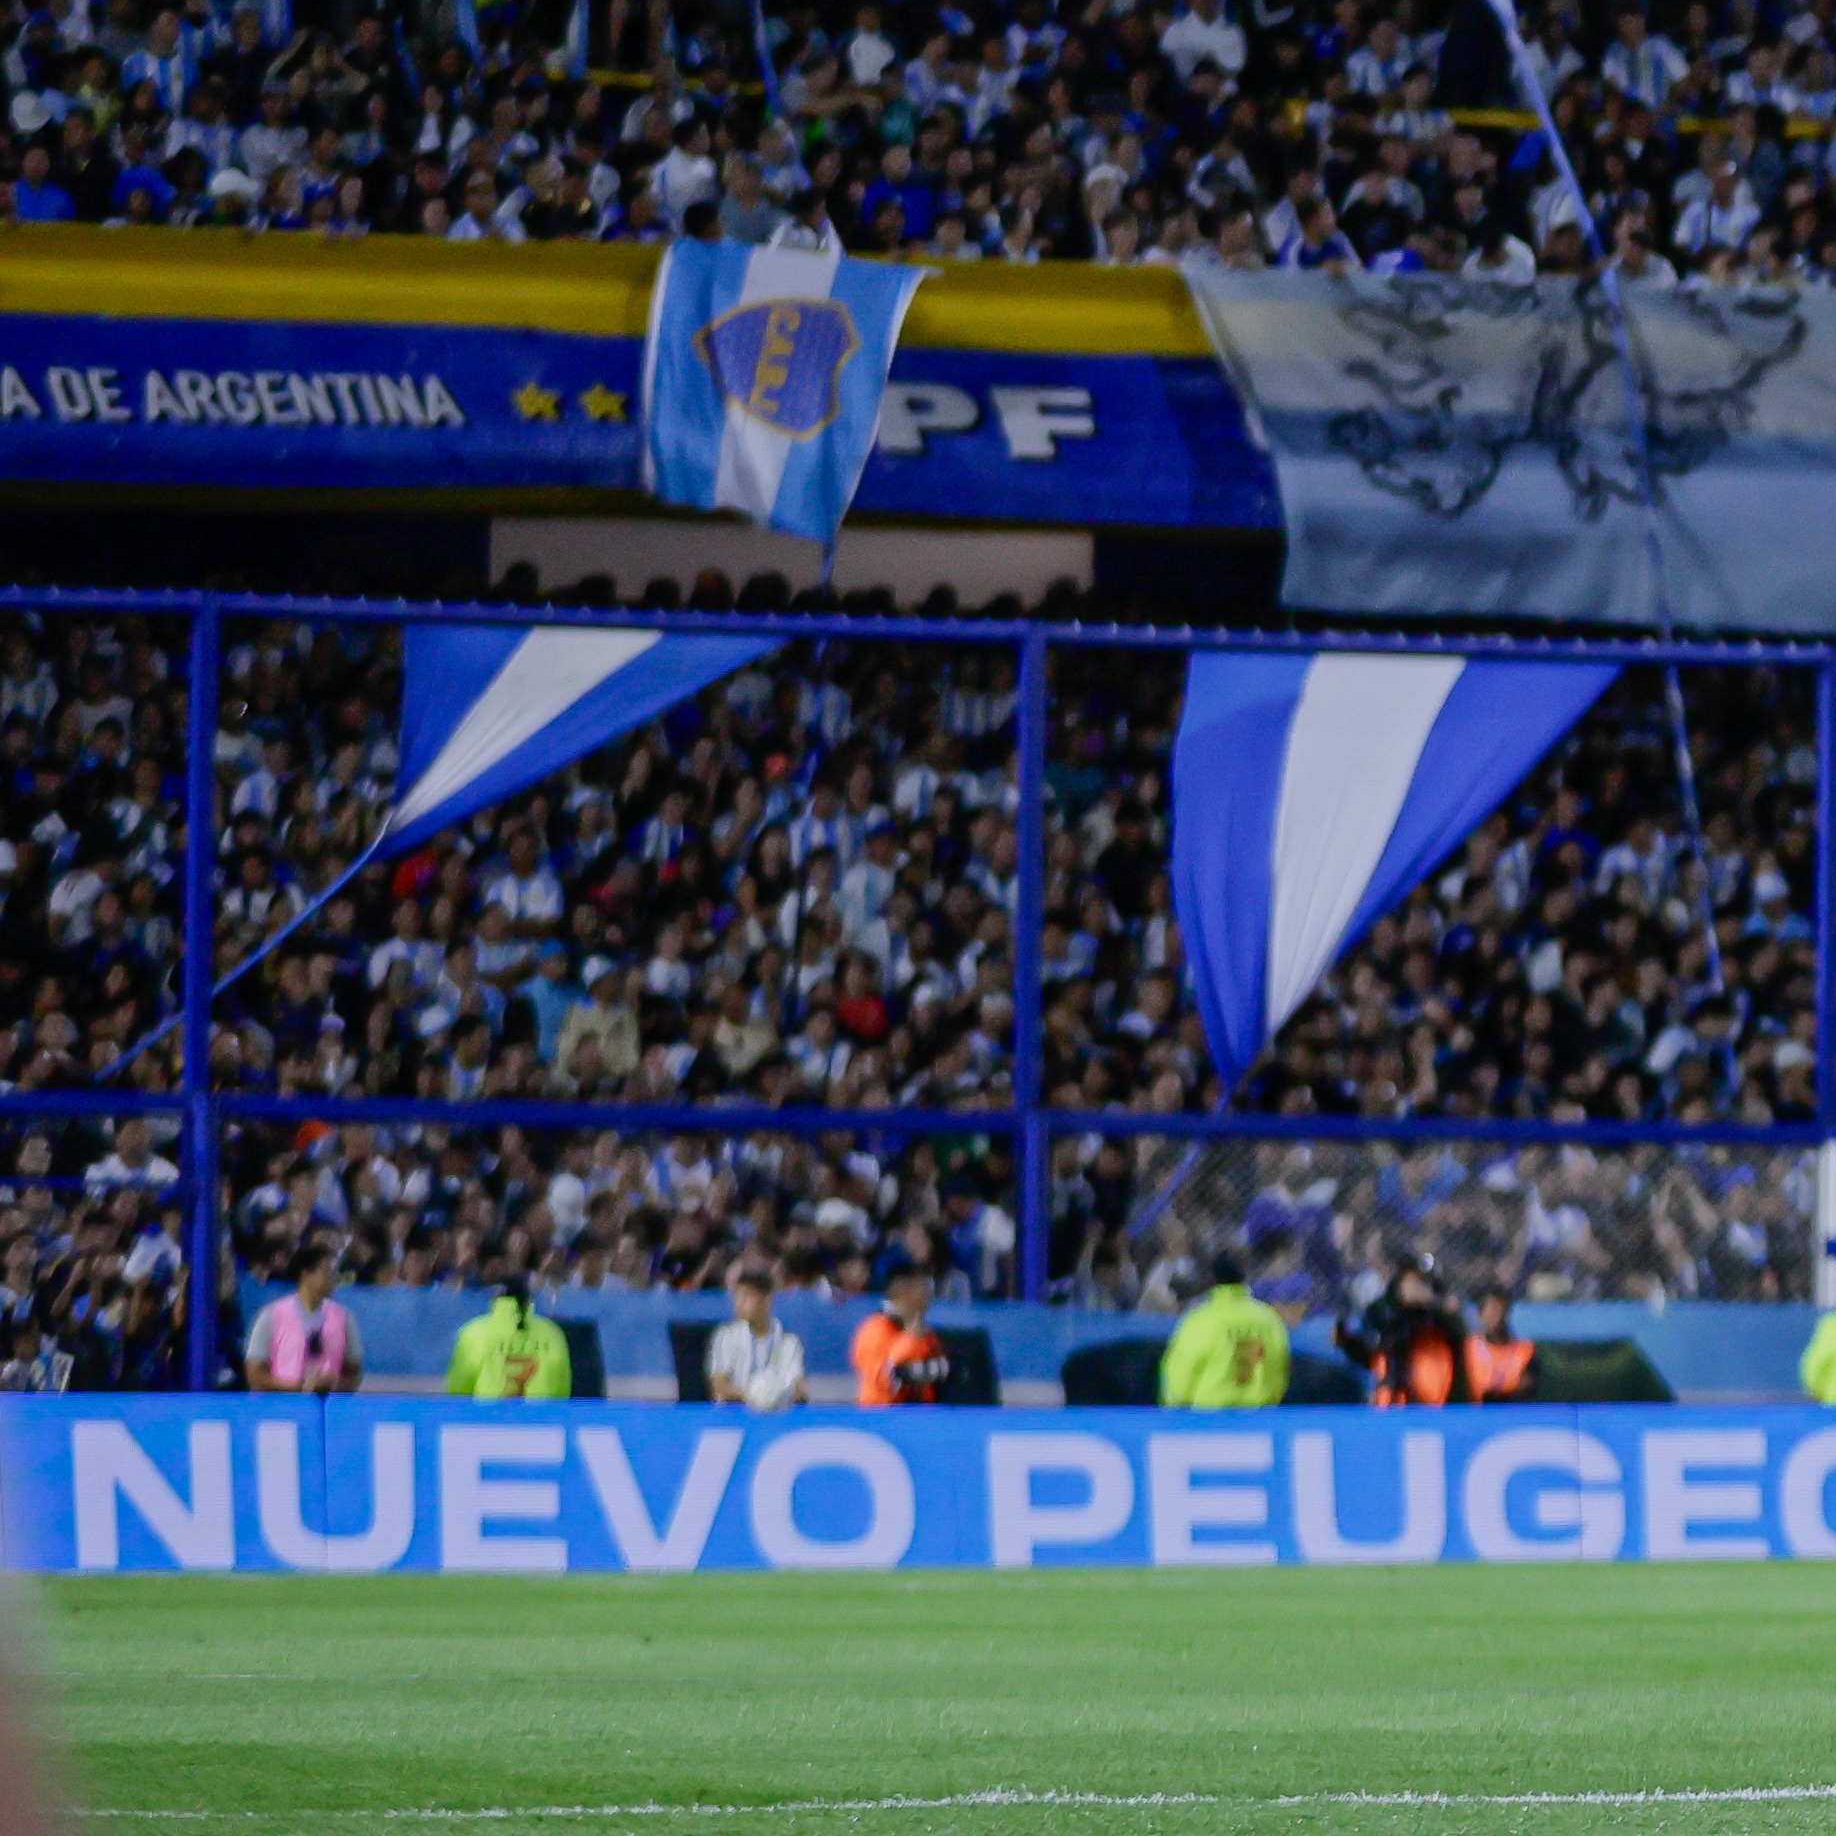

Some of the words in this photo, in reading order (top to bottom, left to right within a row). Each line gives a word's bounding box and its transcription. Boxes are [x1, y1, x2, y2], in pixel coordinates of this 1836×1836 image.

[46, 366, 132, 423] DE
[143, 370, 466, 428] ARGENTINA
[876, 381, 1095, 460] PF
[70, 1418, 916, 1574] NUEVO
